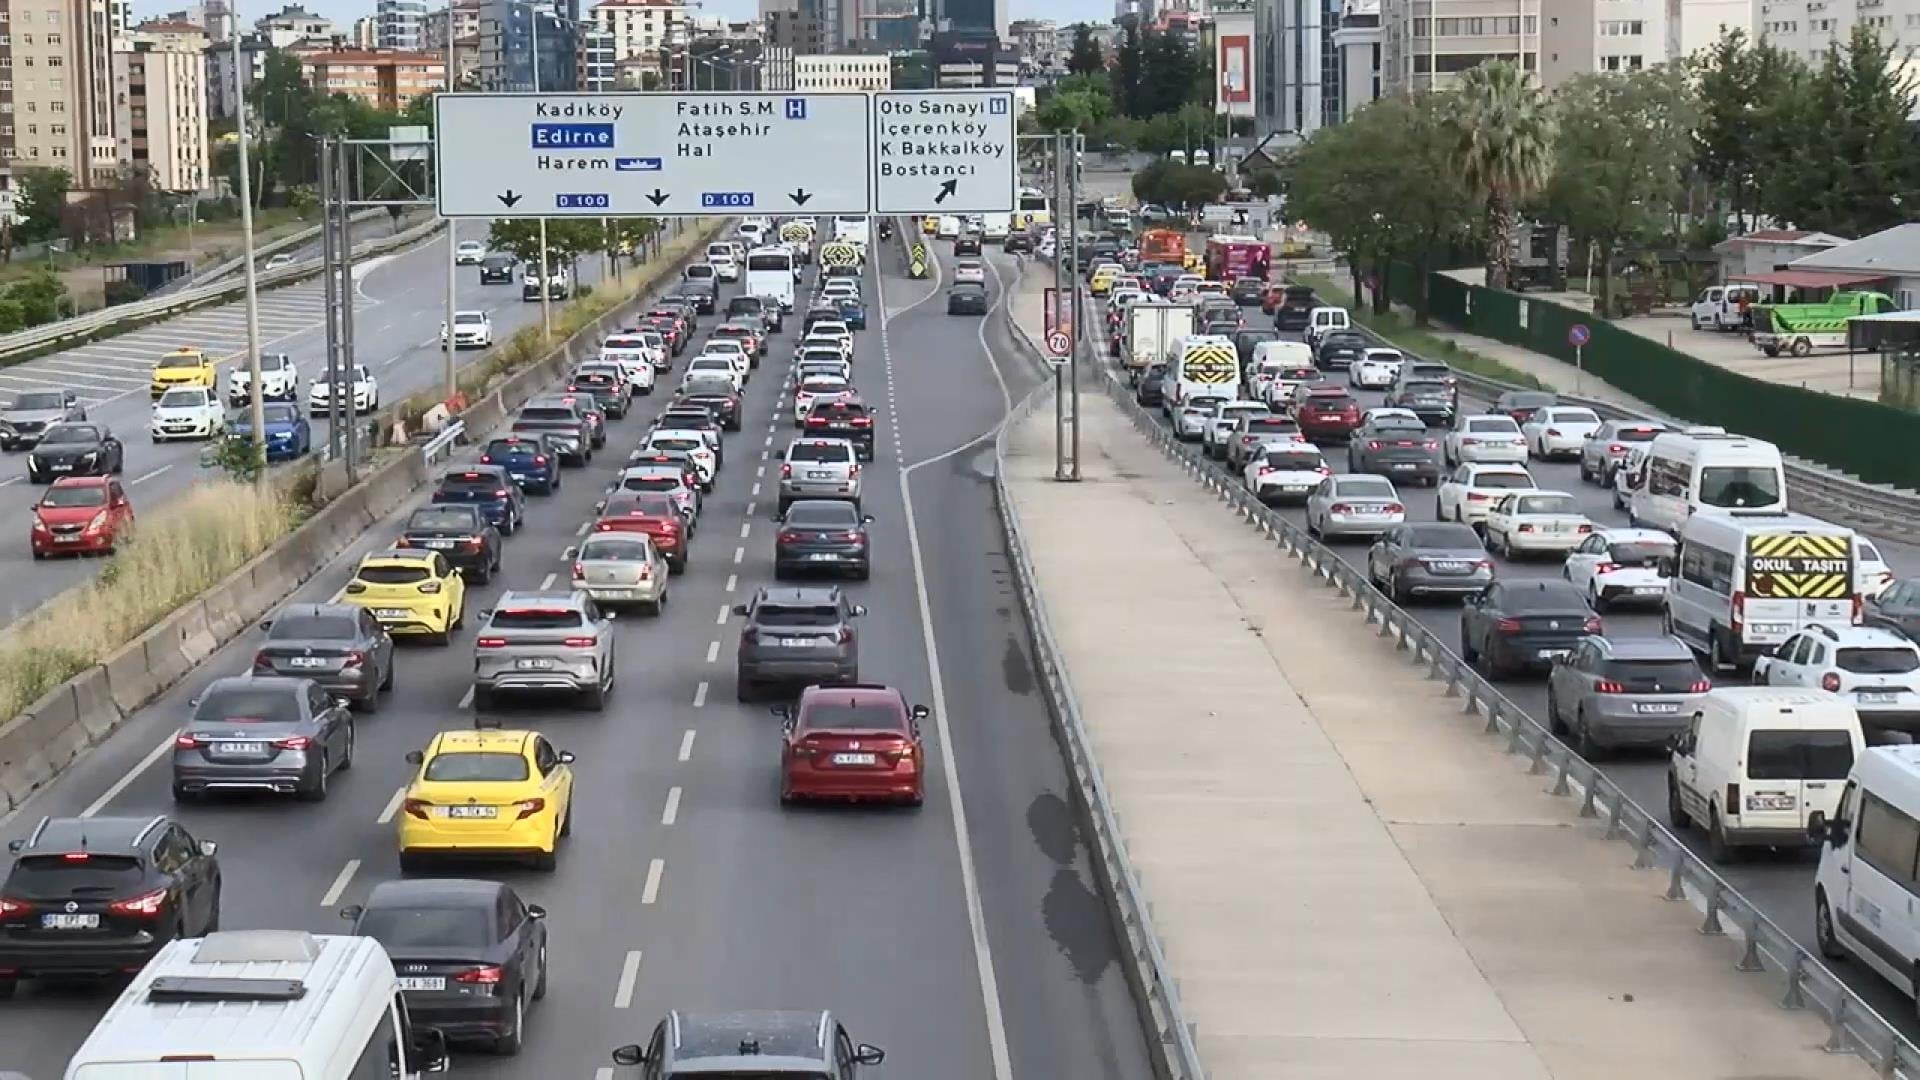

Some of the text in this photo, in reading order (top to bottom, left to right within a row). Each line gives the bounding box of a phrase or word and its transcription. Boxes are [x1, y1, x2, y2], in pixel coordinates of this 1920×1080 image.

[536, 102, 623, 120] Kadıköy
[677, 101, 733, 116] Fatih
[881, 99, 984, 117] Oto Sanayi
[678, 122, 771, 138] Ataşehir
[881, 117, 988, 137] İçerenköy
[536, 128, 609, 144] Edirne
[677, 143, 712, 157] Hal
[902, 141, 1004, 159] Bakkalköy
[537, 155, 609, 169] Harem
[881, 162, 975, 176] Bostancı
[1053, 337, 1067, 349] 70
[1752, 558, 1848, 573] OKUL TAŞITI
